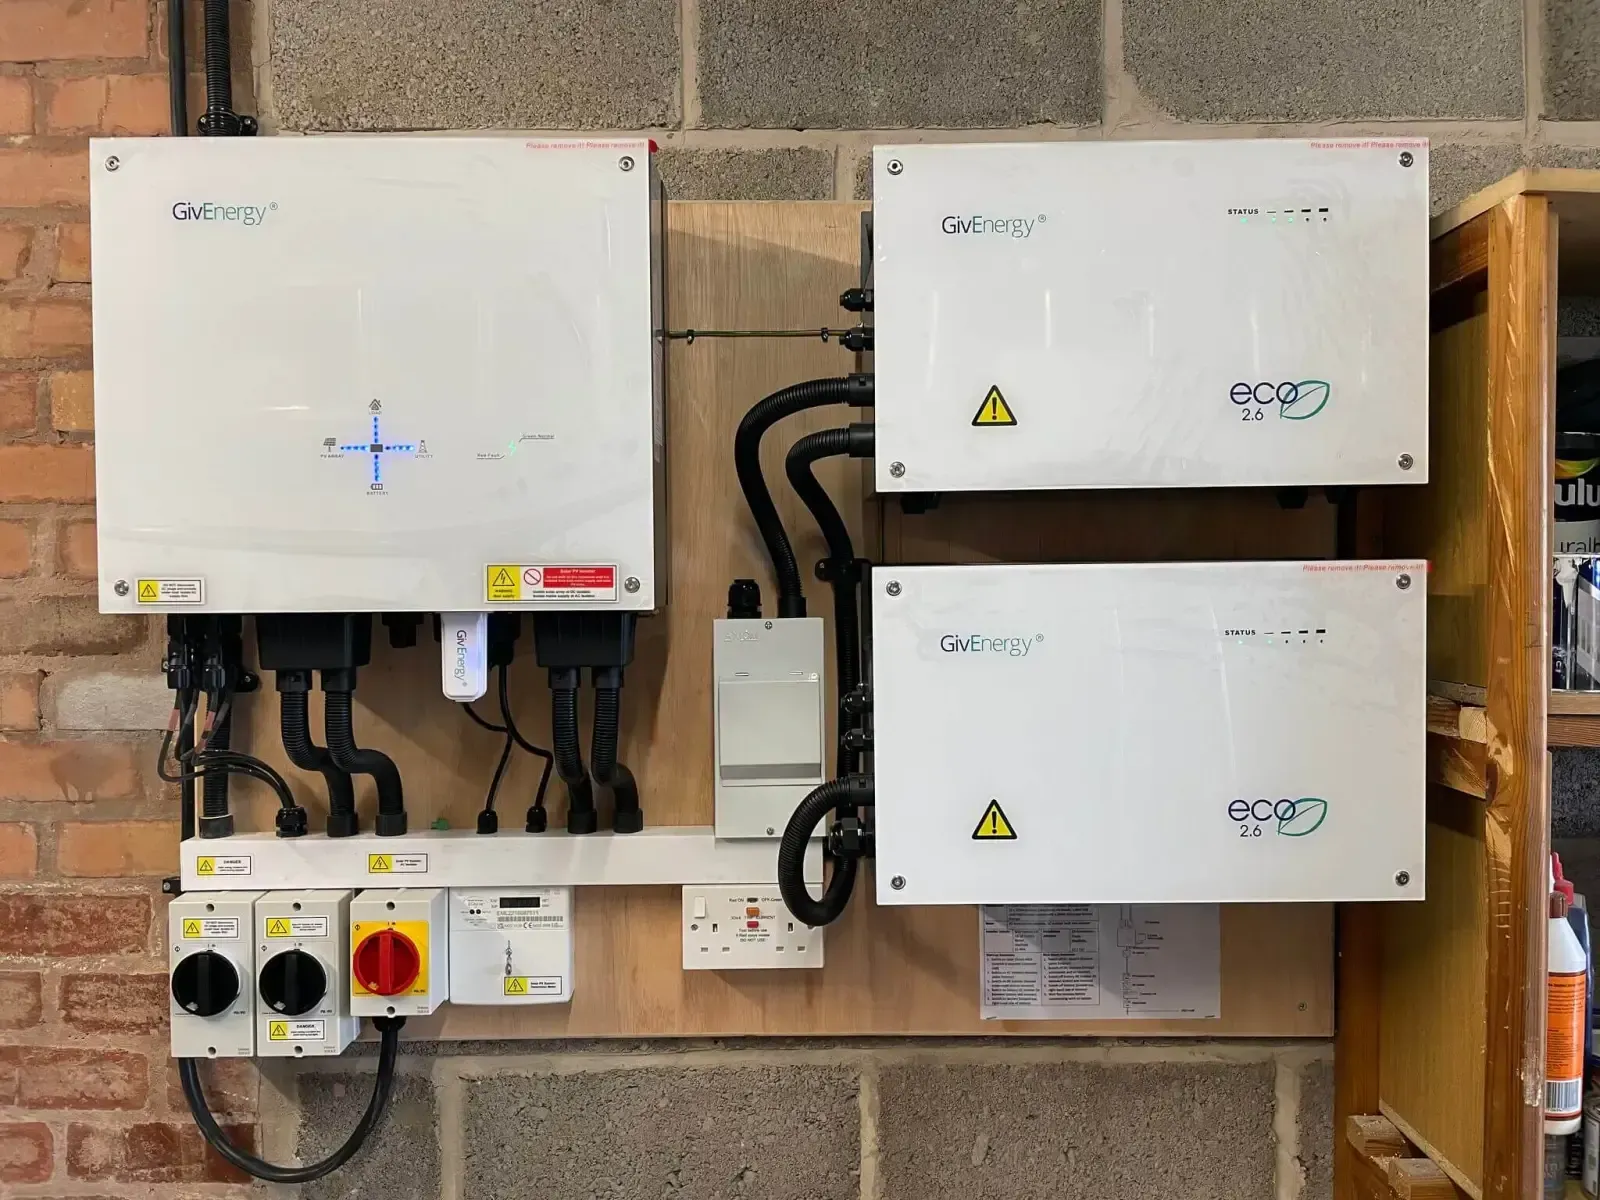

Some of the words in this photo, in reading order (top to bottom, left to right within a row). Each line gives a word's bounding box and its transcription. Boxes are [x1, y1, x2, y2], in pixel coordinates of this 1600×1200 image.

[172, 202, 266, 226] GivEnergy
[942, 215, 1035, 238] GivEnergy
[1230, 381, 1298, 405] eco
[1242, 408, 1264, 421] 2.6
[454, 629, 467, 681] GivEnergy
[940, 634, 1033, 657] GivEnergy
[1228, 798, 1296, 822] eco
[1240, 824, 1262, 837] 2.6
